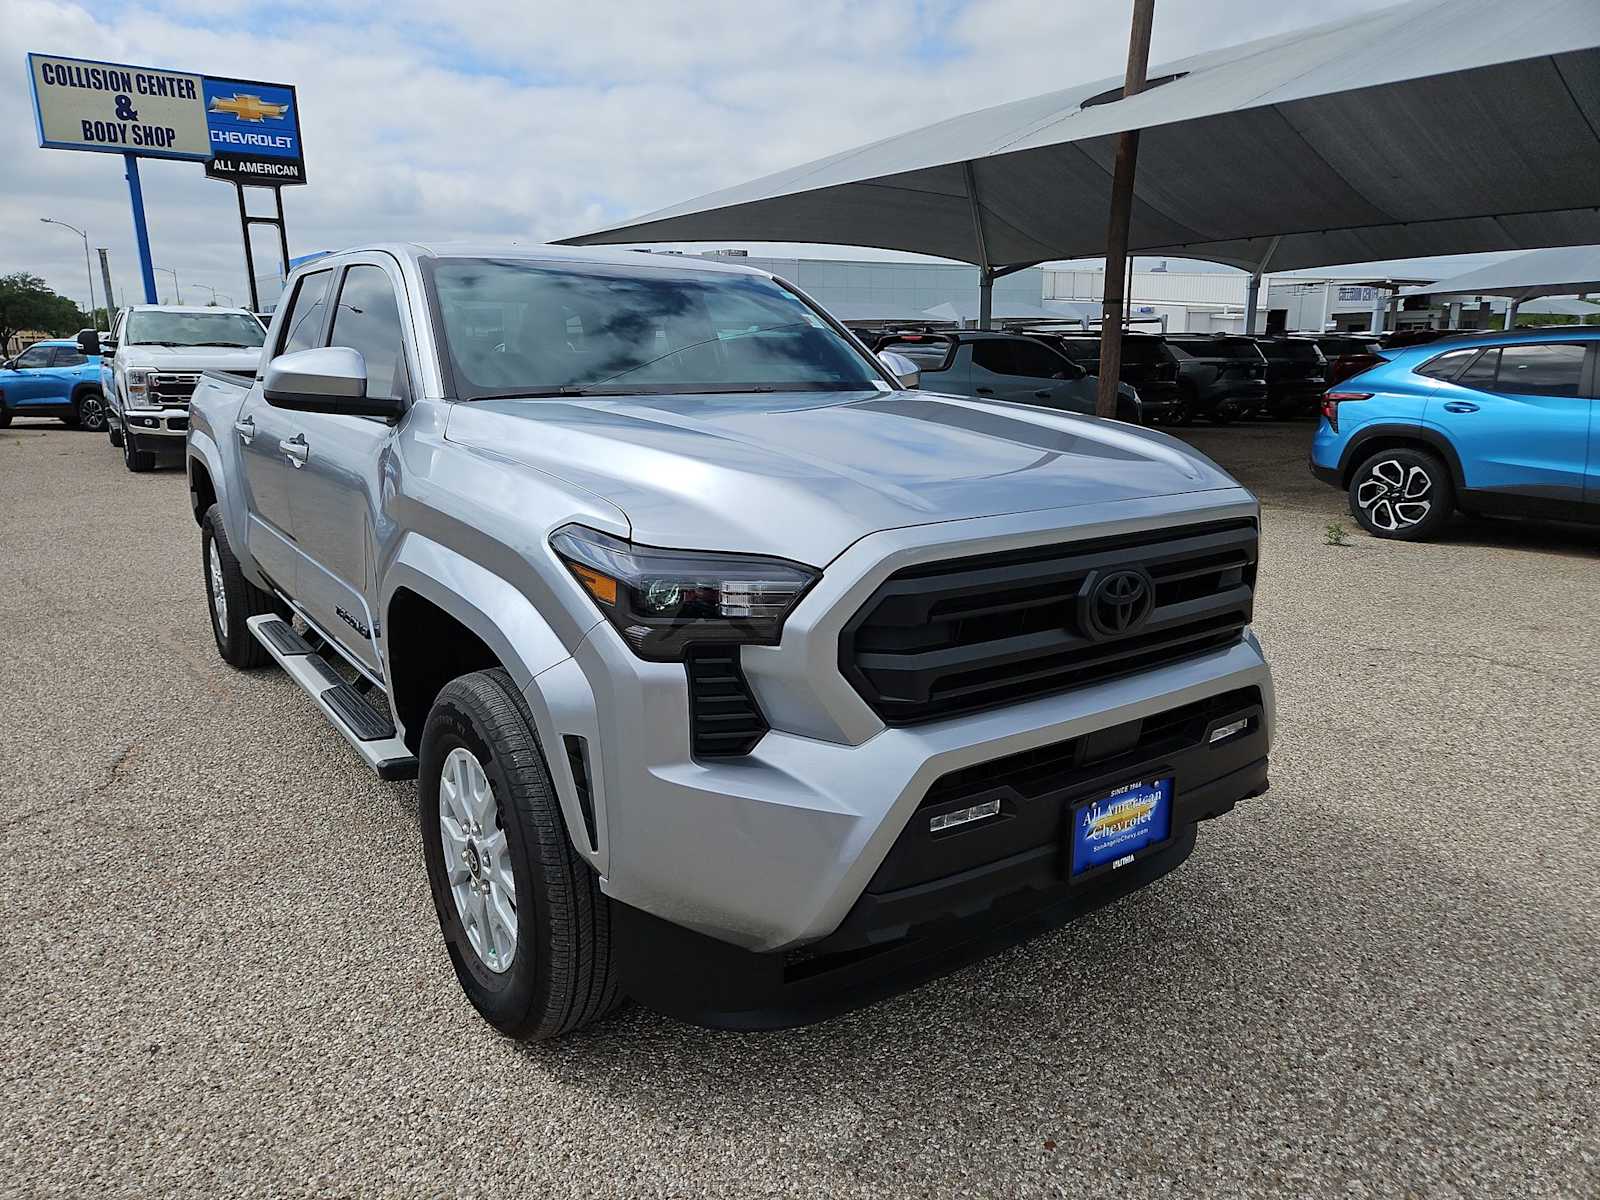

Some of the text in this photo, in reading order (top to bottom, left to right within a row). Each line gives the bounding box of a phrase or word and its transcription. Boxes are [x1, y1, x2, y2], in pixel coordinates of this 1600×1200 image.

[41, 62, 197, 100] COLLISION CENTER
[115, 95, 138, 121] &
[81, 119, 176, 148] BODY SHOP
[210, 129, 293, 149] CHEVROLET
[213, 159, 299, 177] ALL AMERICAN
[1110, 785, 1129, 797] SINCE
[1082, 790, 1162, 827] All American
[1092, 810, 1152, 840] Chevrolet
